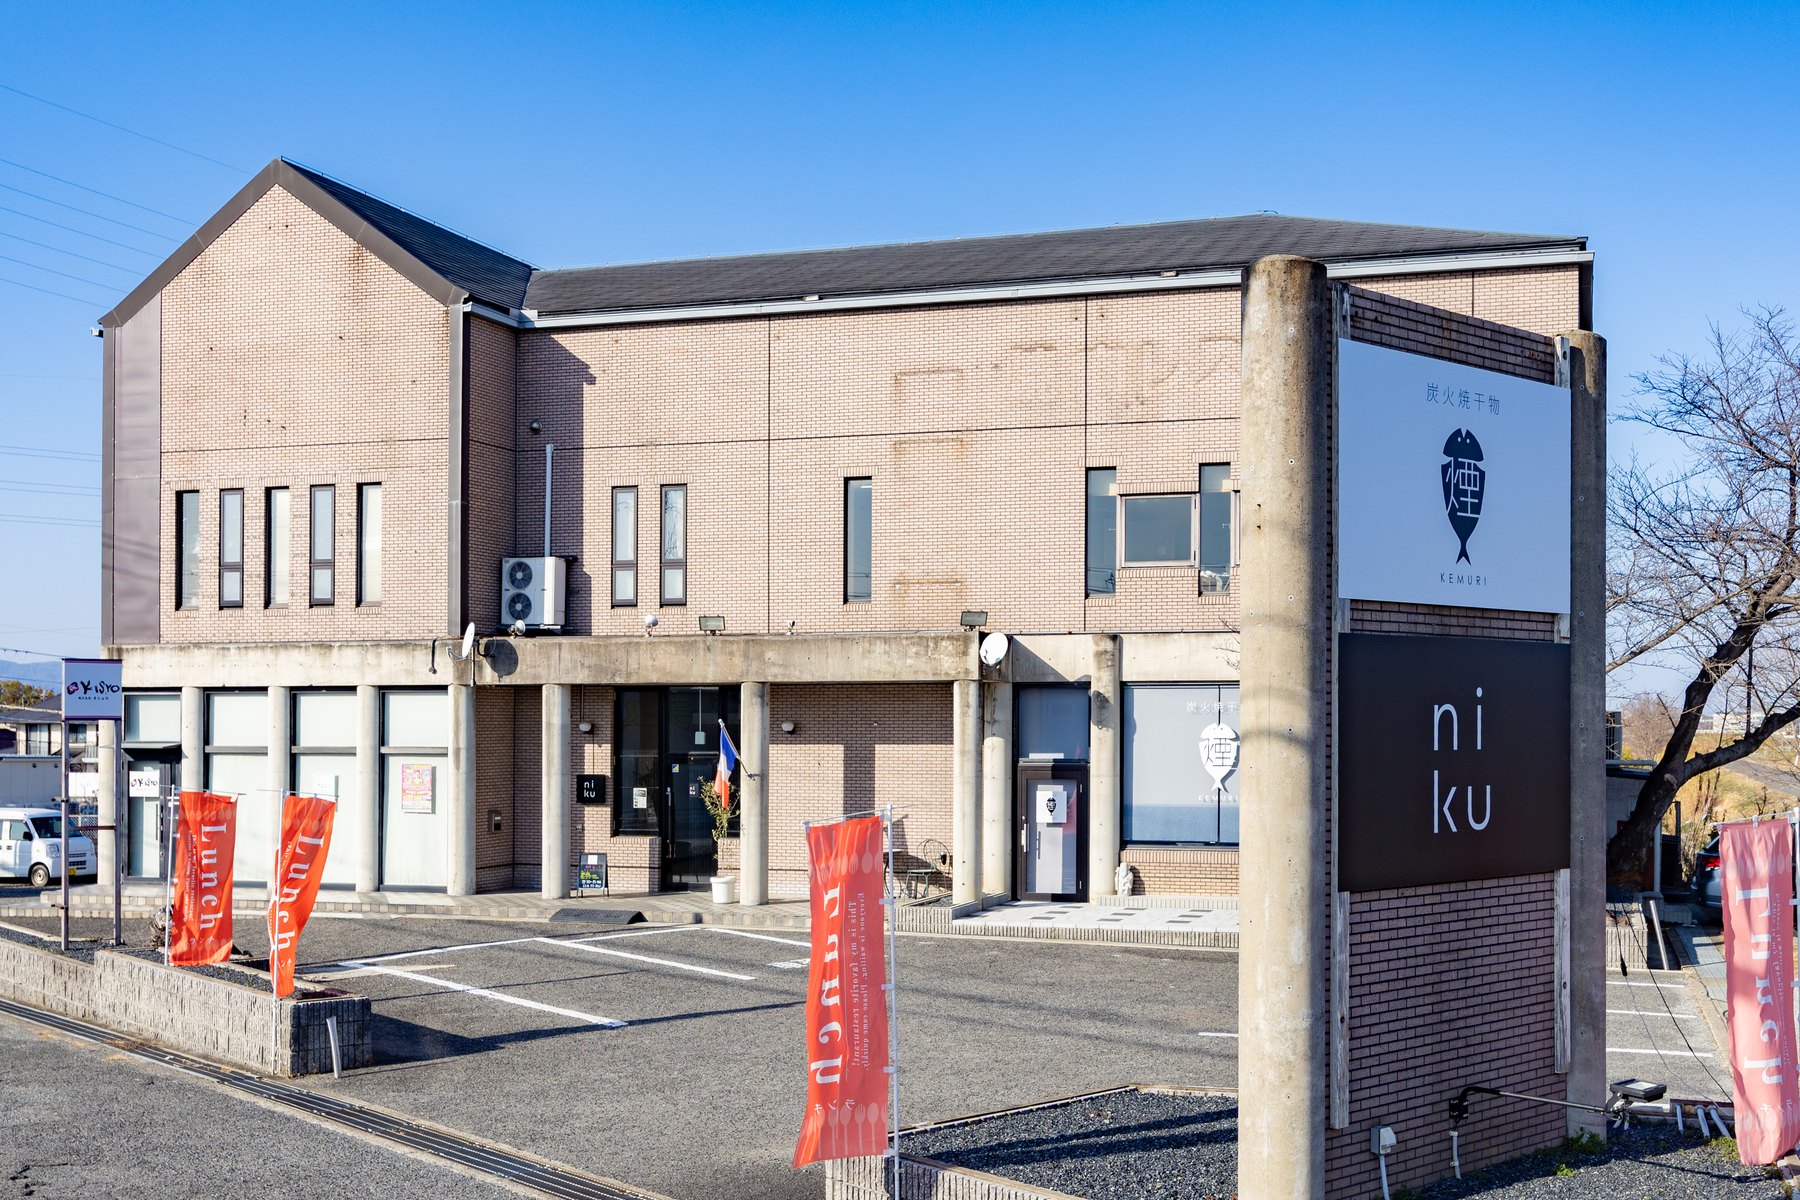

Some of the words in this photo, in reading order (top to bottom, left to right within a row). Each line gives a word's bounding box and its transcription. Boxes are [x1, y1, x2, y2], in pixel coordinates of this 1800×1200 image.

[1426, 382, 1500, 416] 炭火焼干物
[1445, 457, 1480, 518] 煙
[1440, 573, 1487, 586] KEMURI
[1433, 687, 1483, 751] ni
[583, 780, 594, 789] ni
[583, 789, 595, 798] ku
[1433, 770, 1491, 834] ku
[200, 823, 227, 929] Lunch
[277, 833, 325, 951] Lunch
